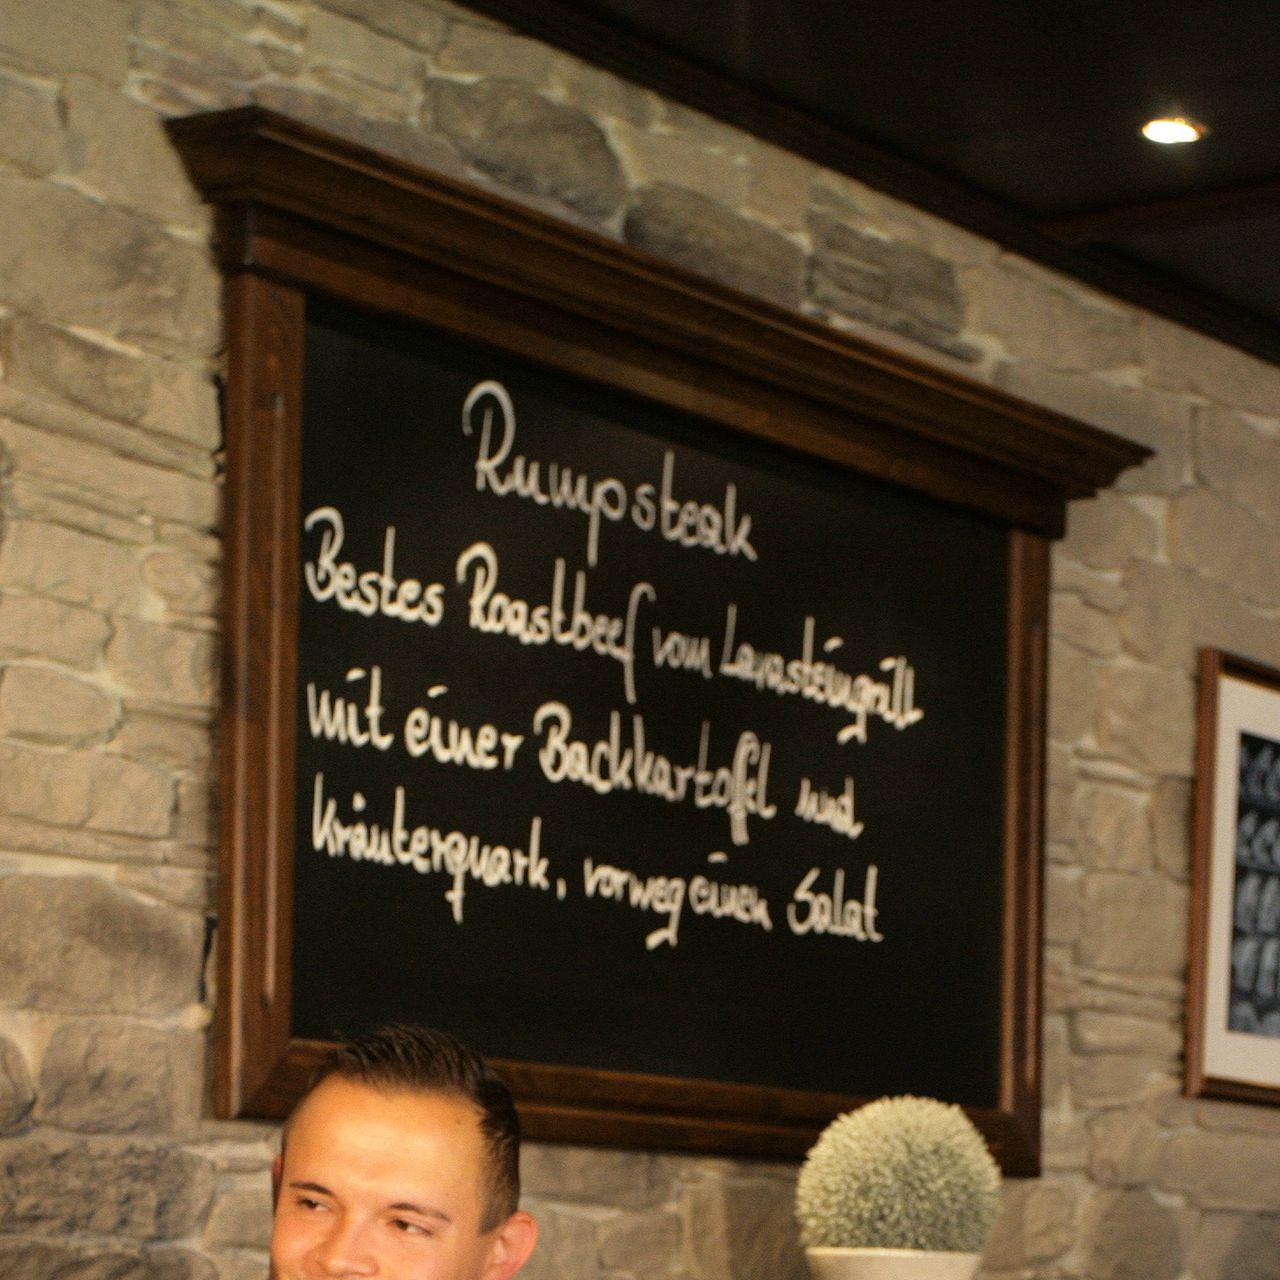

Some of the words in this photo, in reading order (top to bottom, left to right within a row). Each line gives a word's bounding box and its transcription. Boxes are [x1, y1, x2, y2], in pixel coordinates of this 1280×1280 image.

[461, 379, 759, 567] Rumpsteak
[304, 506, 446, 627] Bestes
[455, 541, 658, 705] Roastbeef
[306, 665, 394, 751] mit
[404, 684, 524, 771] einer
[794, 775, 864, 840] und
[787, 864, 884, 943] Salat
